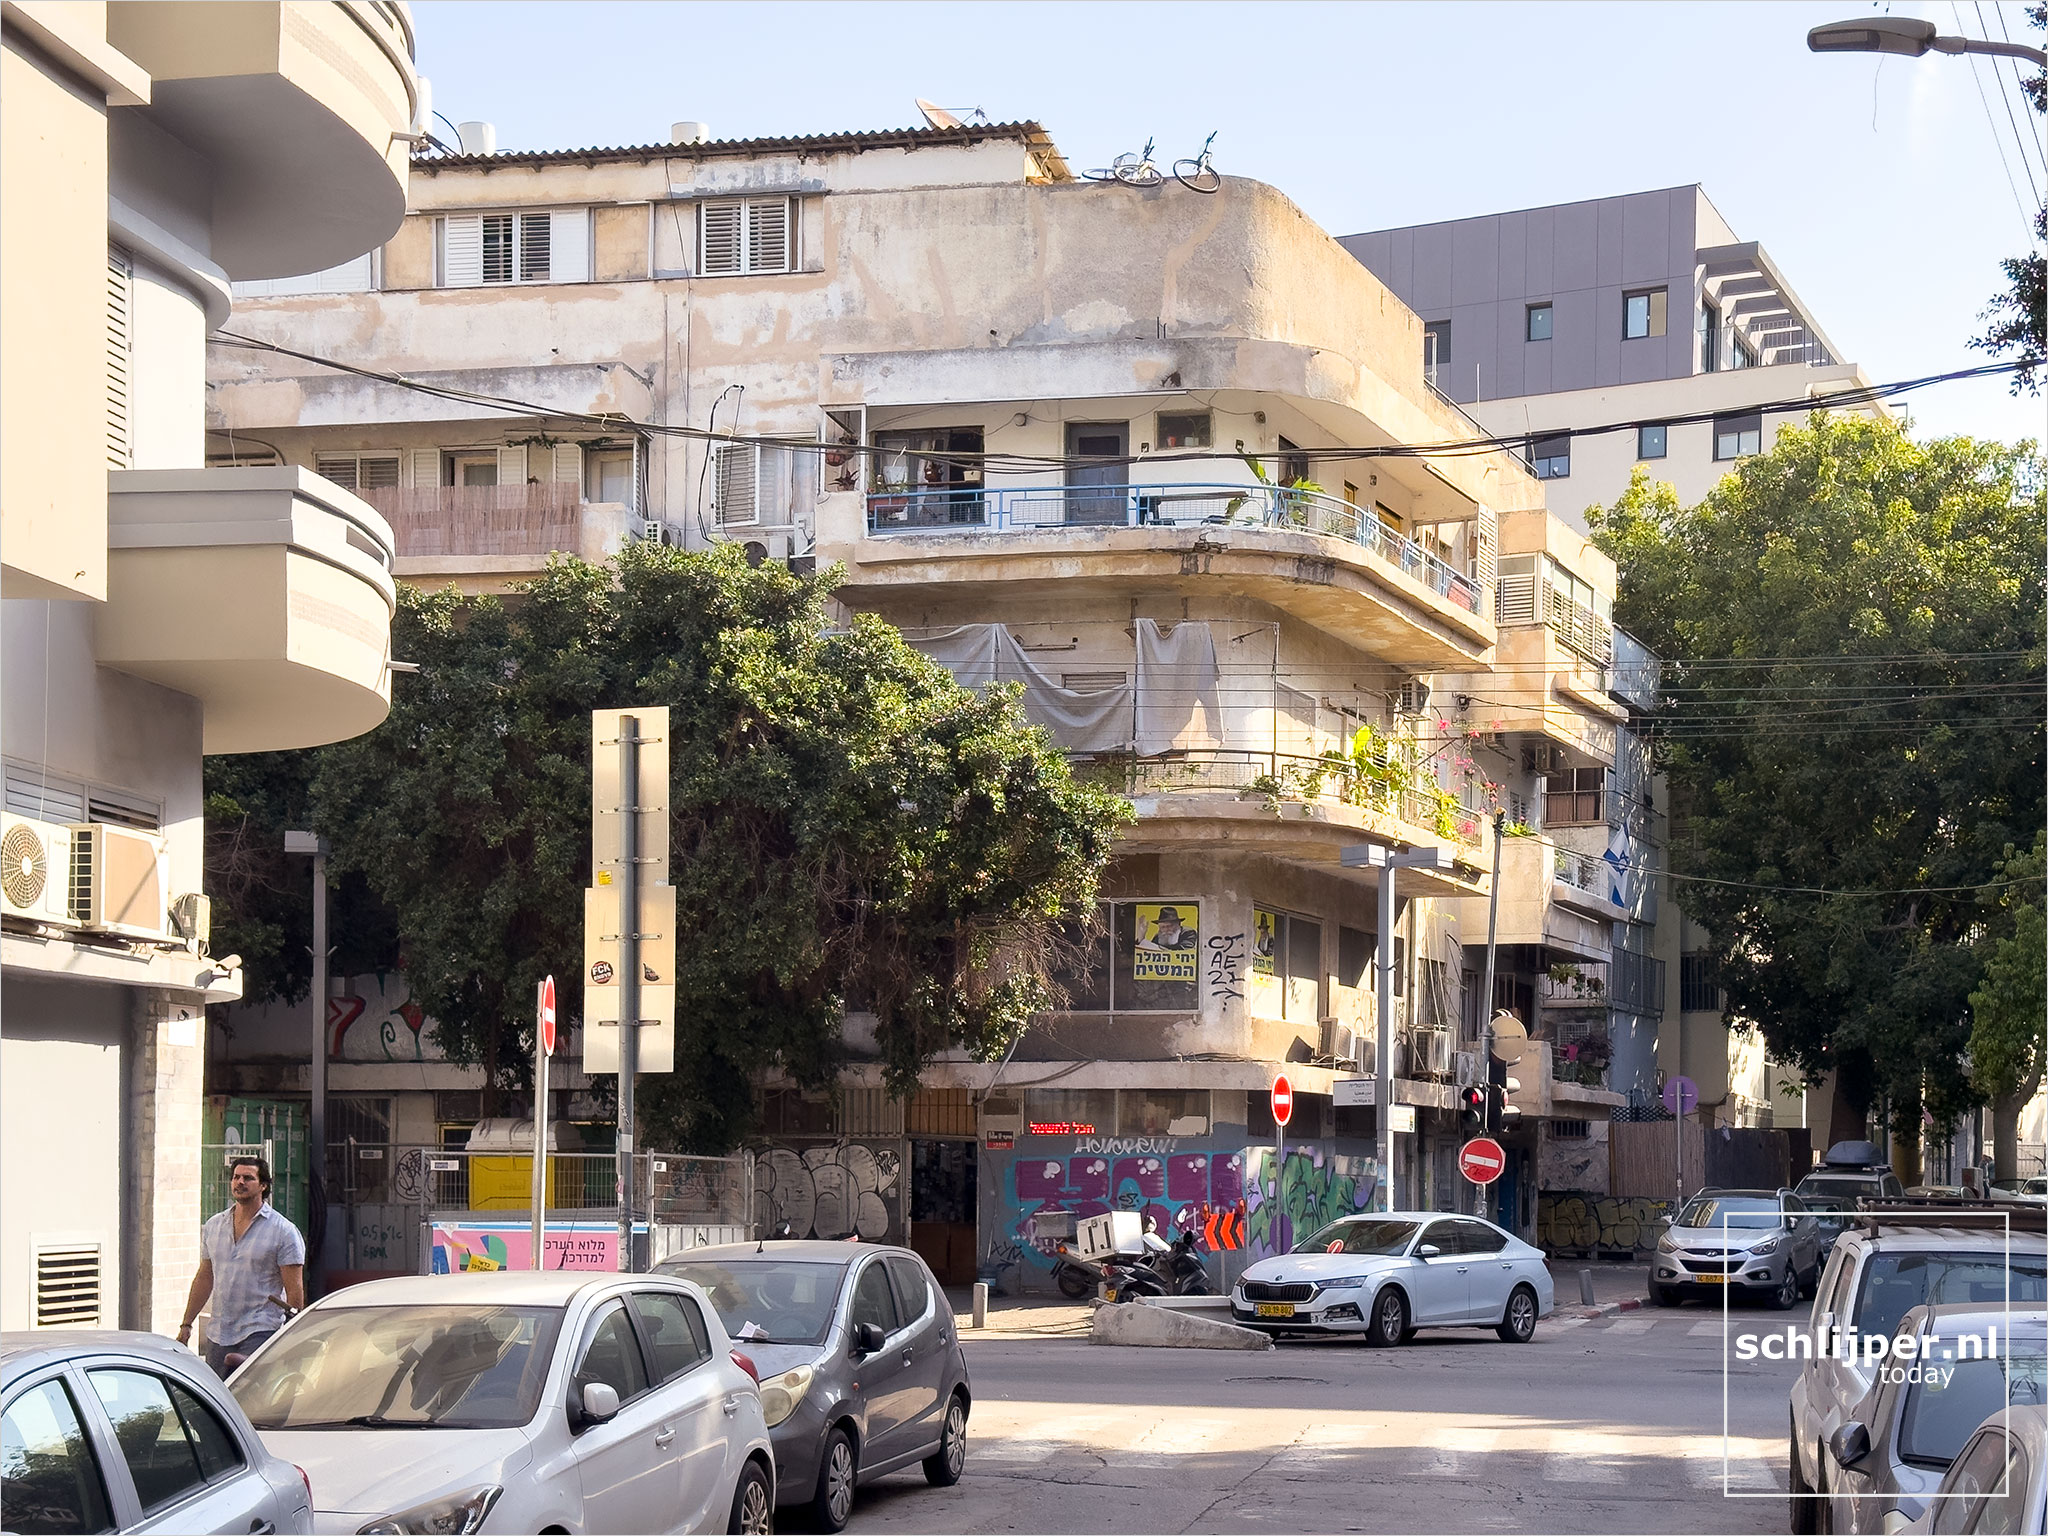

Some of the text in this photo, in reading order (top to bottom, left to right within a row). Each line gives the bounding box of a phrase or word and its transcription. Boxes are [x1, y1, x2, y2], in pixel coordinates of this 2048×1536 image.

[1136, 951, 1195, 963] יחי המלך
[1136, 965, 1194, 977] המשיח
[1029, 1121, 1096, 1134] הכל לחשמל
[545, 1239, 605, 1250] מלוא הערכ
